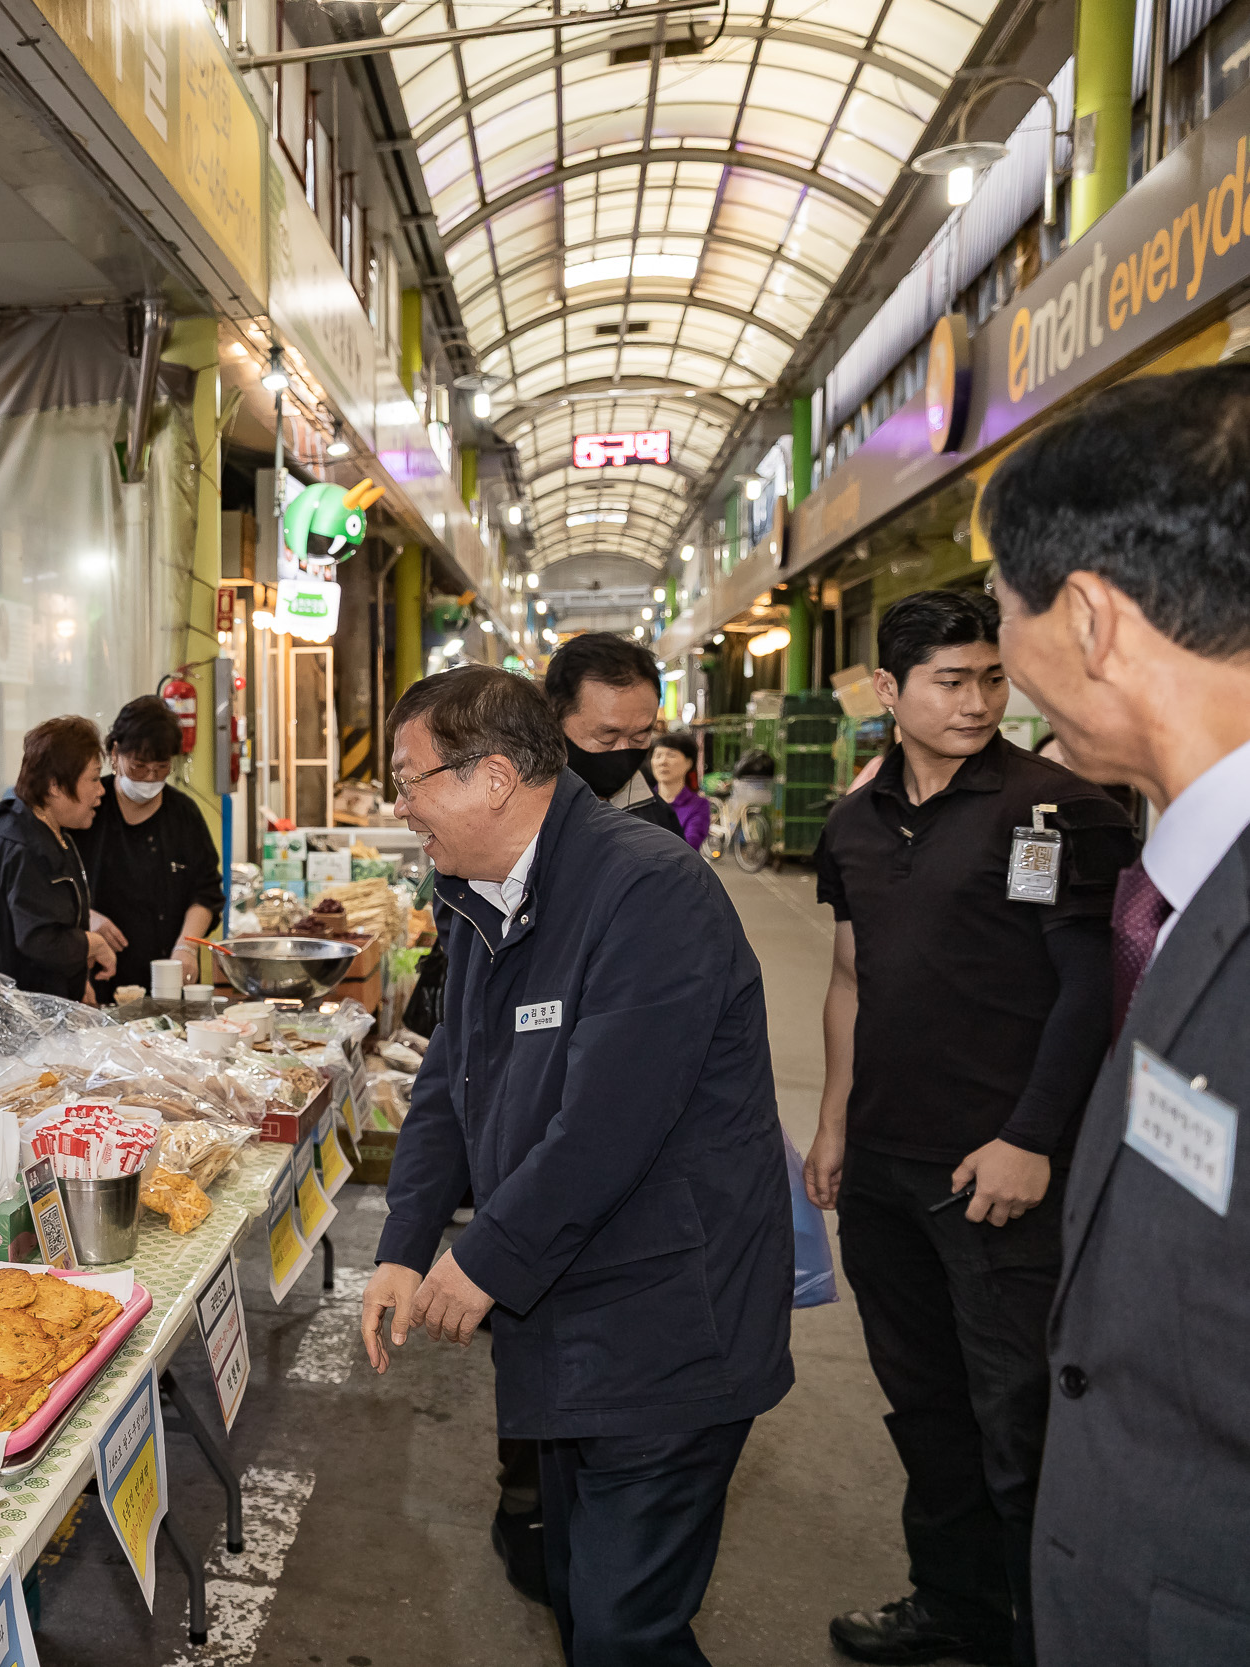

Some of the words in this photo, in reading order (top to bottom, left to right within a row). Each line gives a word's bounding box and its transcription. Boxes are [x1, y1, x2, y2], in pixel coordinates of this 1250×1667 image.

[1008, 240, 1108, 404] emart
[1107, 135, 1250, 332] everyd
[574, 431, 670, 468] 5구역
